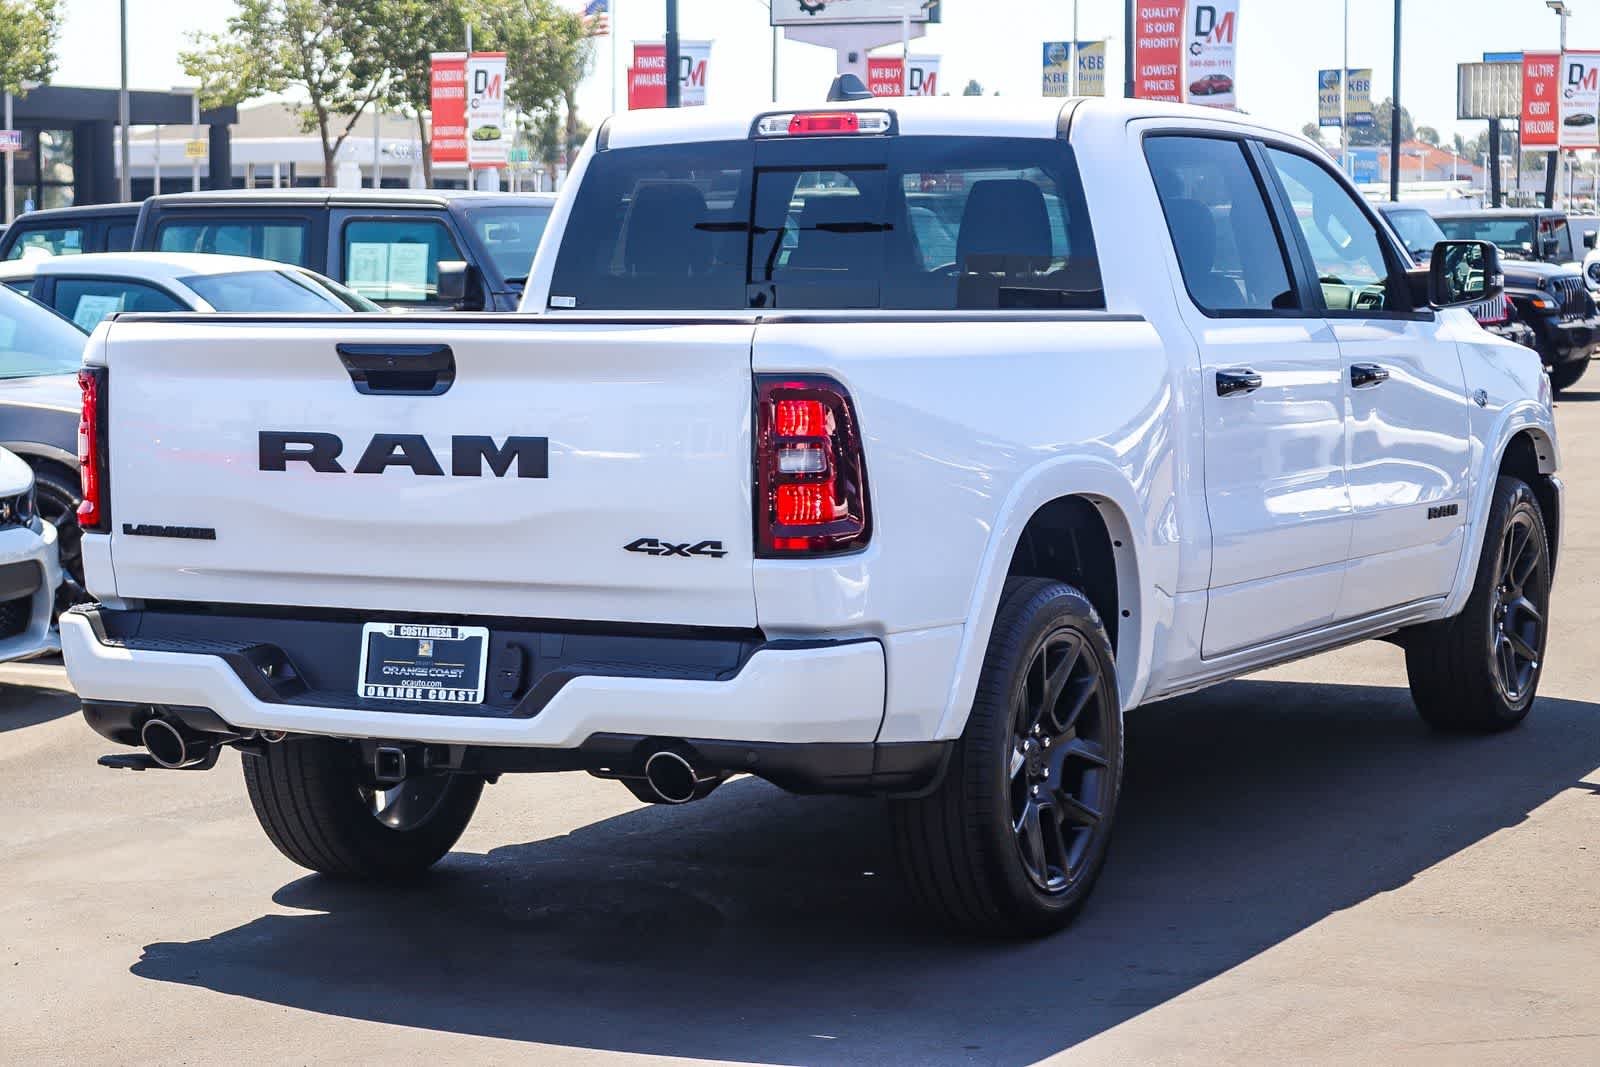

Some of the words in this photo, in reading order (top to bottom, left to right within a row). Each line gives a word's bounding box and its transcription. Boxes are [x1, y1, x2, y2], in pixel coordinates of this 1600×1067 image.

[1141, 7, 1180, 19] QUALITY
[1145, 23, 1154, 33] IS
[1154, 22, 1175, 33] OUR
[1140, 37, 1180, 49] PRIORITY
[1078, 55, 1104, 70] KBB
[871, 68, 884, 79] WE
[885, 67, 902, 79] BUY
[1142, 64, 1178, 76] LOWEST
[1528, 64, 1539, 77] ALL
[1539, 64, 1554, 77] TYPE
[872, 83, 892, 95] CARS
[1144, 79, 1175, 91] PRICES
[1535, 83, 1544, 96] OF
[1529, 102, 1551, 115] CREDIT
[1525, 121, 1555, 135] WELCOME
[258, 430, 549, 479] RAM
[623, 537, 729, 559] 4x4
[400, 626, 428, 637] COSTA
[428, 627, 453, 638] MESA
[382, 666, 428, 677] ORANGE
[428, 667, 465, 678] COAST
[401, 679, 443, 688] ocauto.com
[367, 686, 423, 700] ORANGE
[428, 689, 477, 702] COAST
